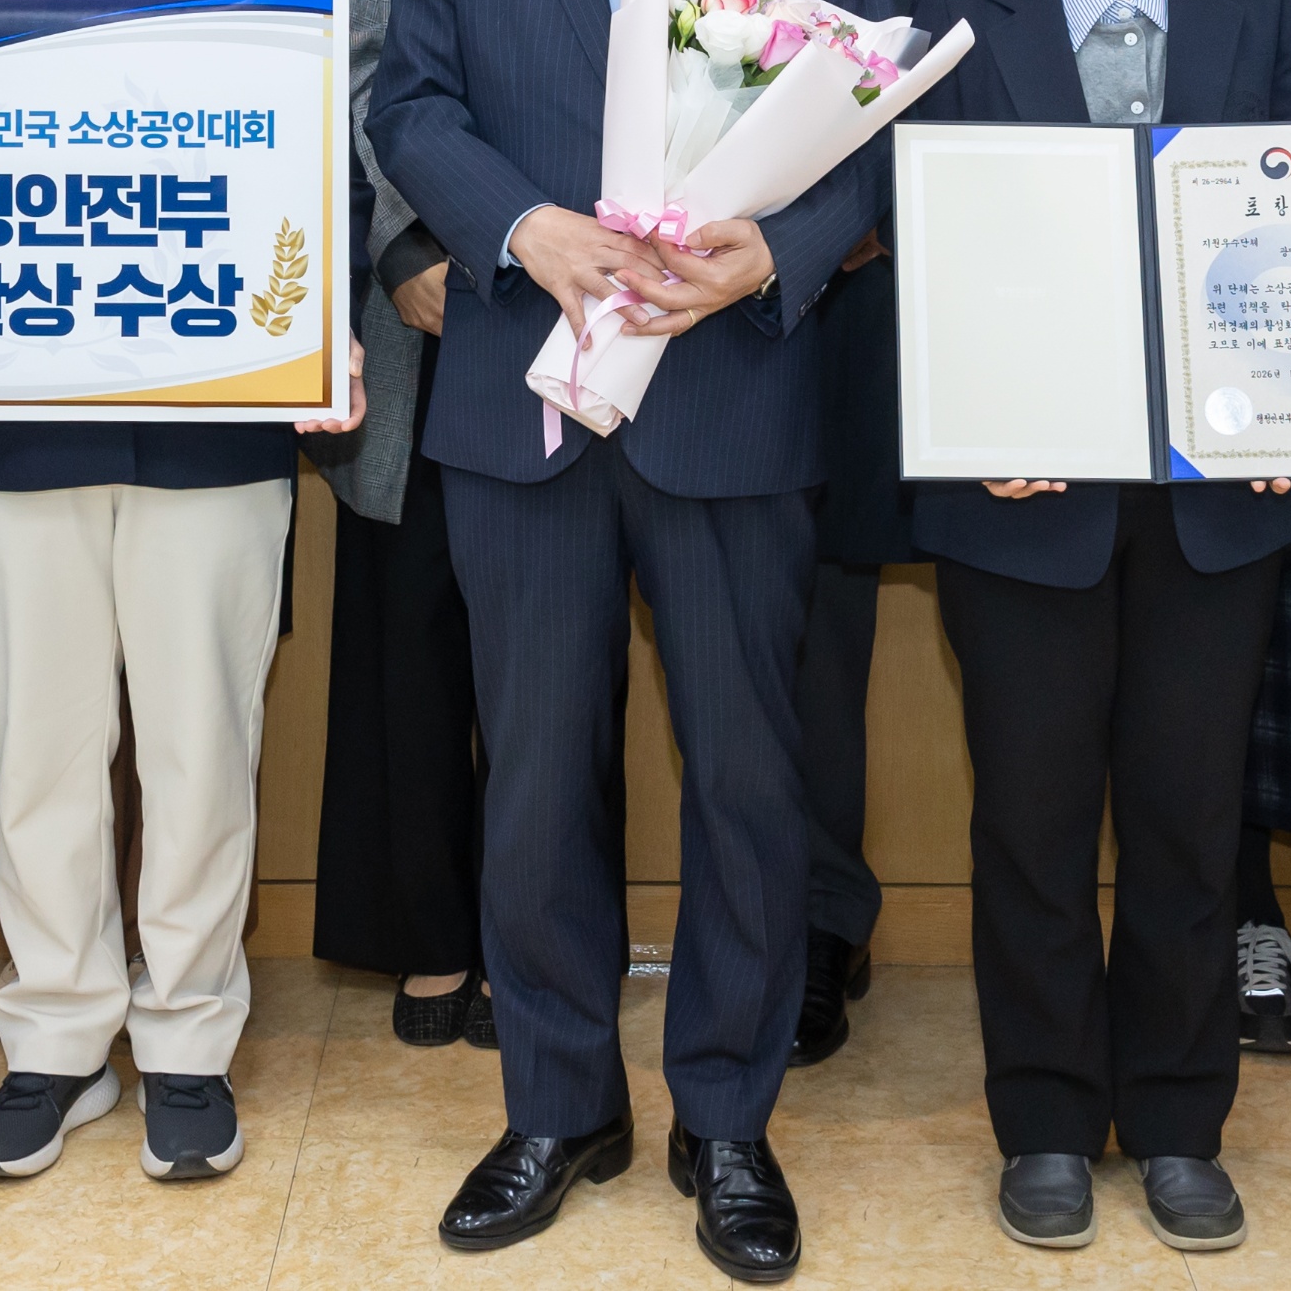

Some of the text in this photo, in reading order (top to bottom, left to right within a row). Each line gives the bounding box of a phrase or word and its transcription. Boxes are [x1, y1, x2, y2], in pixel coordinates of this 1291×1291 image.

[68, 109, 276, 149] 소상공인대회
[1212, 283, 1222, 295] 위
[1227, 282, 1260, 295] 단체는
[95, 263, 244, 338] 수상
[1206, 302, 1227, 314] 관련
[1238, 301, 1270, 314] 정책을
[1207, 319, 1259, 333] 지역경제의
[1246, 338, 1267, 351] 이에
